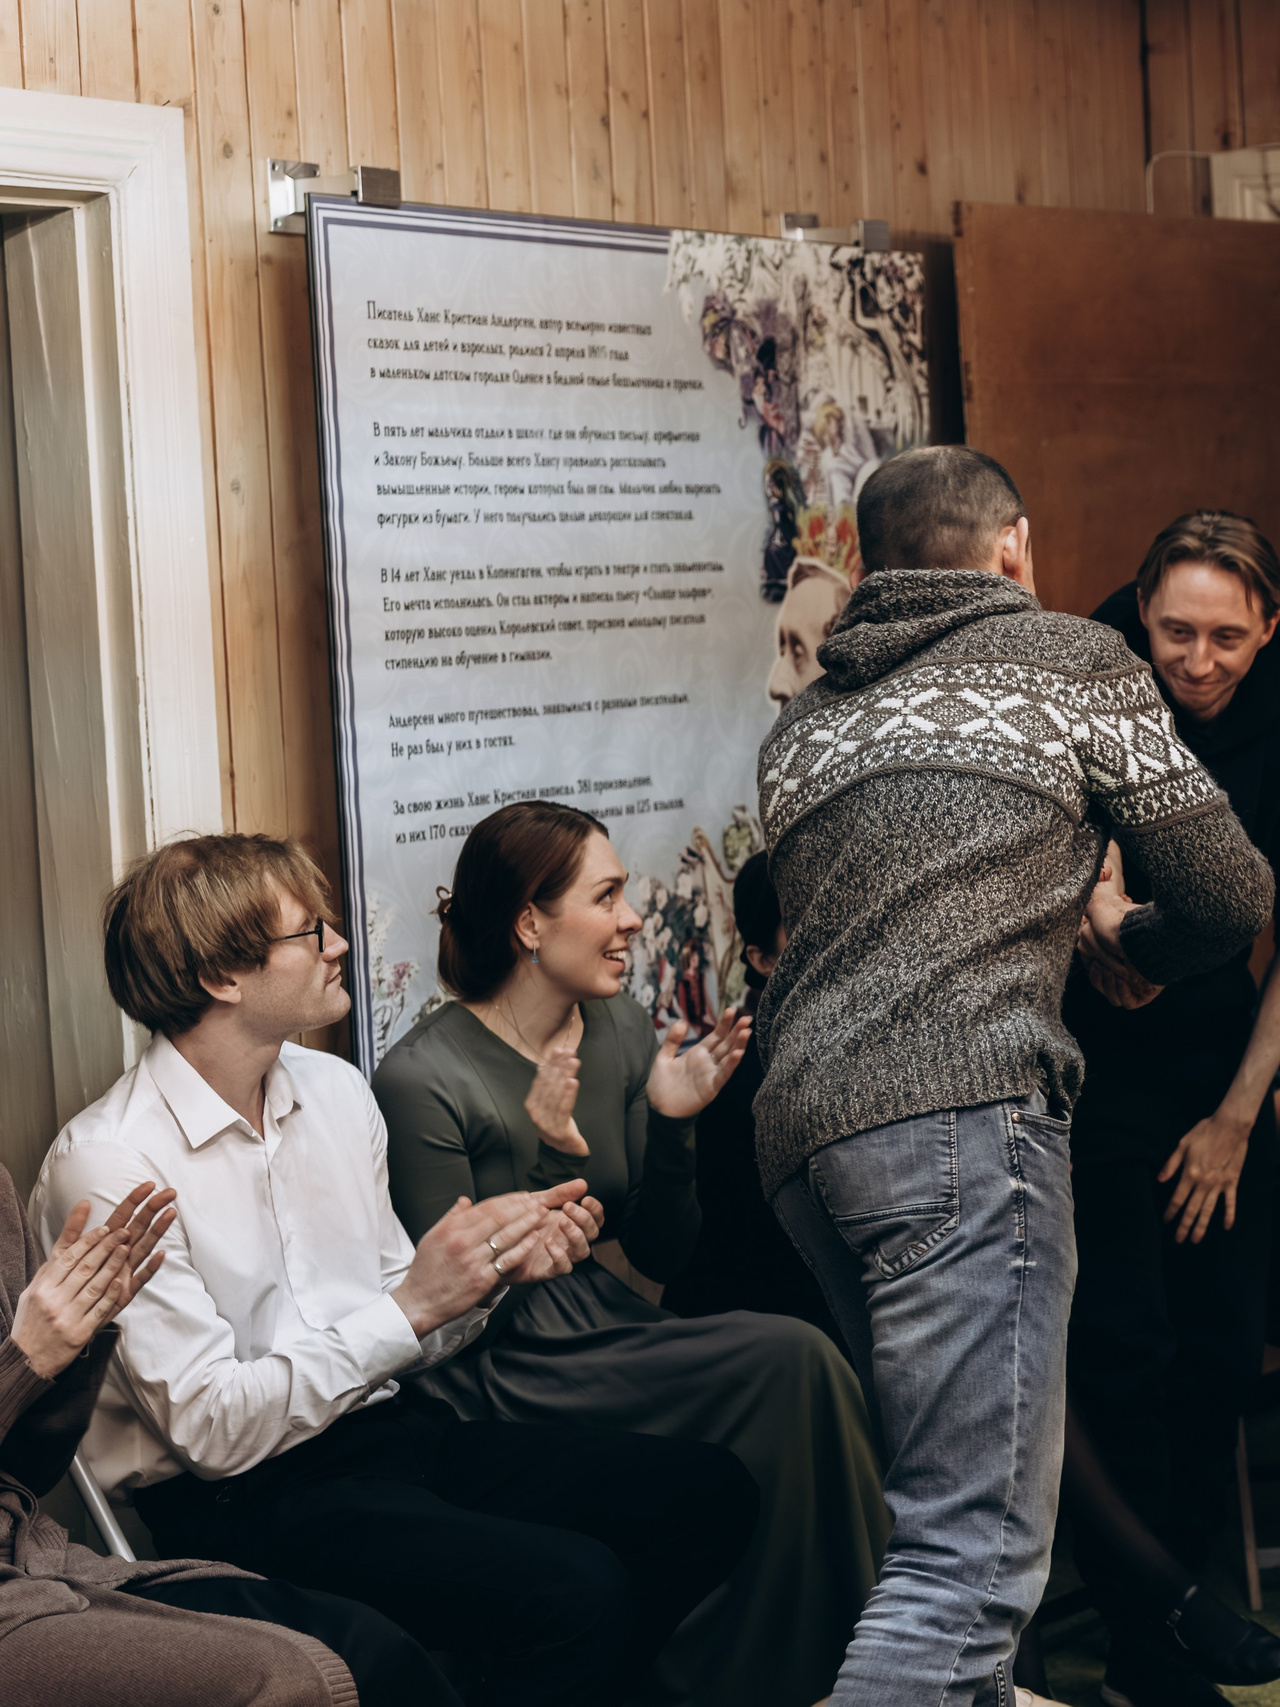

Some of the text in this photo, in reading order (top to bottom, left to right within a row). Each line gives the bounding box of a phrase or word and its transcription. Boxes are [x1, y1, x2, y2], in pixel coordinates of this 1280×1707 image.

[366, 300, 414, 321] Писатель
[417, 307, 441, 322] Ханс
[444, 309, 488, 327] Кристиан
[367, 337, 401, 349] сказок
[403, 339, 420, 350] для
[423, 337, 450, 351] детей
[452, 343, 458, 351] и
[546, 342, 552, 357] 2
[555, 346, 585, 361] апреля
[370, 367, 376, 378] в
[379, 368, 431, 380] маленьком
[433, 370, 471, 381] датском
[473, 371, 510, 385] городке
[513, 368, 543, 383] Оденсе
[546, 373, 551, 384] в
[553, 370, 585, 385] бедной
[373, 421, 381, 437] В
[384, 425, 408, 437] пять
[410, 426, 425, 437] лет
[428, 427, 473, 438] мальчика
[475, 427, 506, 438] отдали
[508, 428, 513, 438] в
[565, 429, 576, 439] он
[374, 454, 381, 465] и
[383, 450, 417, 469] Закону
[468, 451, 503, 466] Больше
[506, 455, 531, 466] всего
[534, 451, 560, 470] Хансу
[376, 483, 450, 495] вымышленные
[494, 484, 525, 499] героем
[528, 484, 565, 498] которых
[567, 480, 584, 494] был
[587, 484, 597, 494] он
[377, 511, 420, 528] фигурки
[422, 513, 433, 523] из
[473, 508, 481, 522] У
[483, 512, 504, 523] него
[506, 511, 556, 525] получались
[380, 567, 387, 583] В
[391, 567, 401, 582] 14
[404, 571, 420, 581] лет
[423, 566, 447, 581] Ханс
[449, 569, 476, 585] уехал
[479, 569, 484, 579] в
[605, 564, 610, 574] в
[382, 596, 401, 611] Его
[403, 599, 431, 610] мечта
[496, 591, 510, 606] Он
[512, 594, 531, 605] стал
[384, 627, 425, 643] которую
[428, 626, 463, 639] высоко
[464, 624, 497, 636] оценил
[499, 618, 556, 638] Королевский
[385, 655, 438, 669] стипендию
[441, 655, 452, 666] на
[455, 650, 498, 668] обучение
[501, 652, 507, 662] в
[389, 713, 435, 730] Андерсен
[437, 711, 466, 723] много
[391, 741, 404, 756] Не
[407, 744, 423, 759] раз
[425, 738, 444, 753] был
[447, 740, 453, 755] у
[455, 739, 473, 750] них
[475, 738, 481, 748] в
[393, 800, 405, 814] За
[407, 800, 432, 812] свою
[435, 796, 465, 809] жизнь
[467, 791, 490, 806] Ханс
[493, 788, 537, 806] Кристиан
[538, 785, 575, 798] написал
[395, 831, 407, 843] из
[409, 829, 427, 842] них
[429, 823, 446, 840] 170
